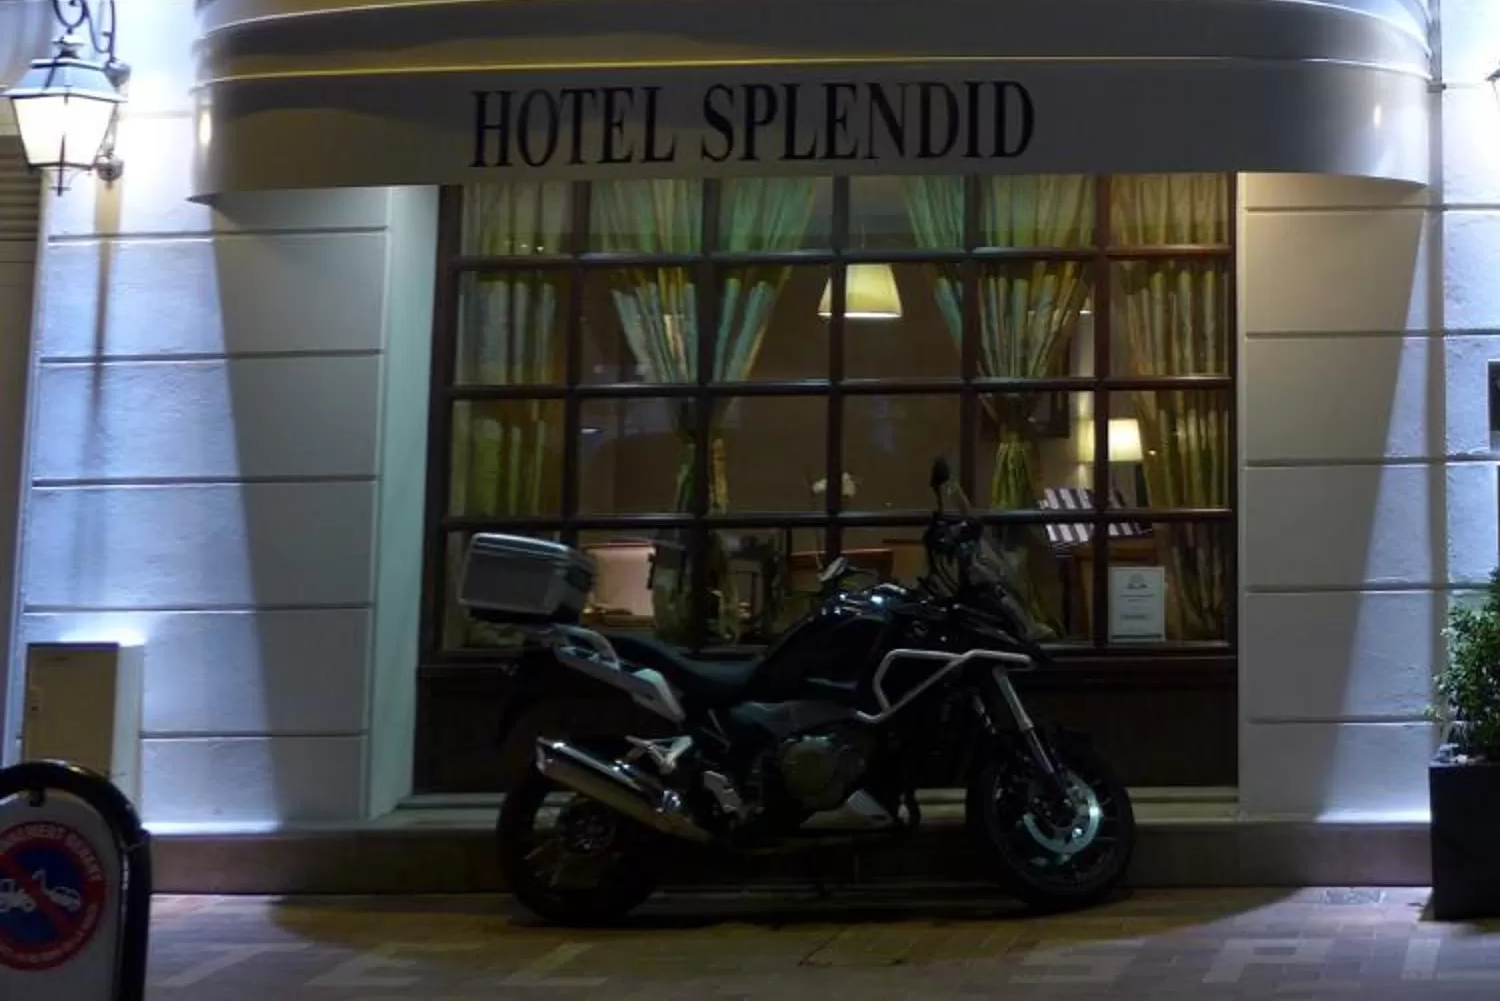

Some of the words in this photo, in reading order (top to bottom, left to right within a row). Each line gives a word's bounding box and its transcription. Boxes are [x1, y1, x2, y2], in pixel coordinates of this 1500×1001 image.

[468, 85, 676, 168] HOTEL
[701, 80, 1036, 162] SPLENDID
[154, 942, 608, 987] TEL
